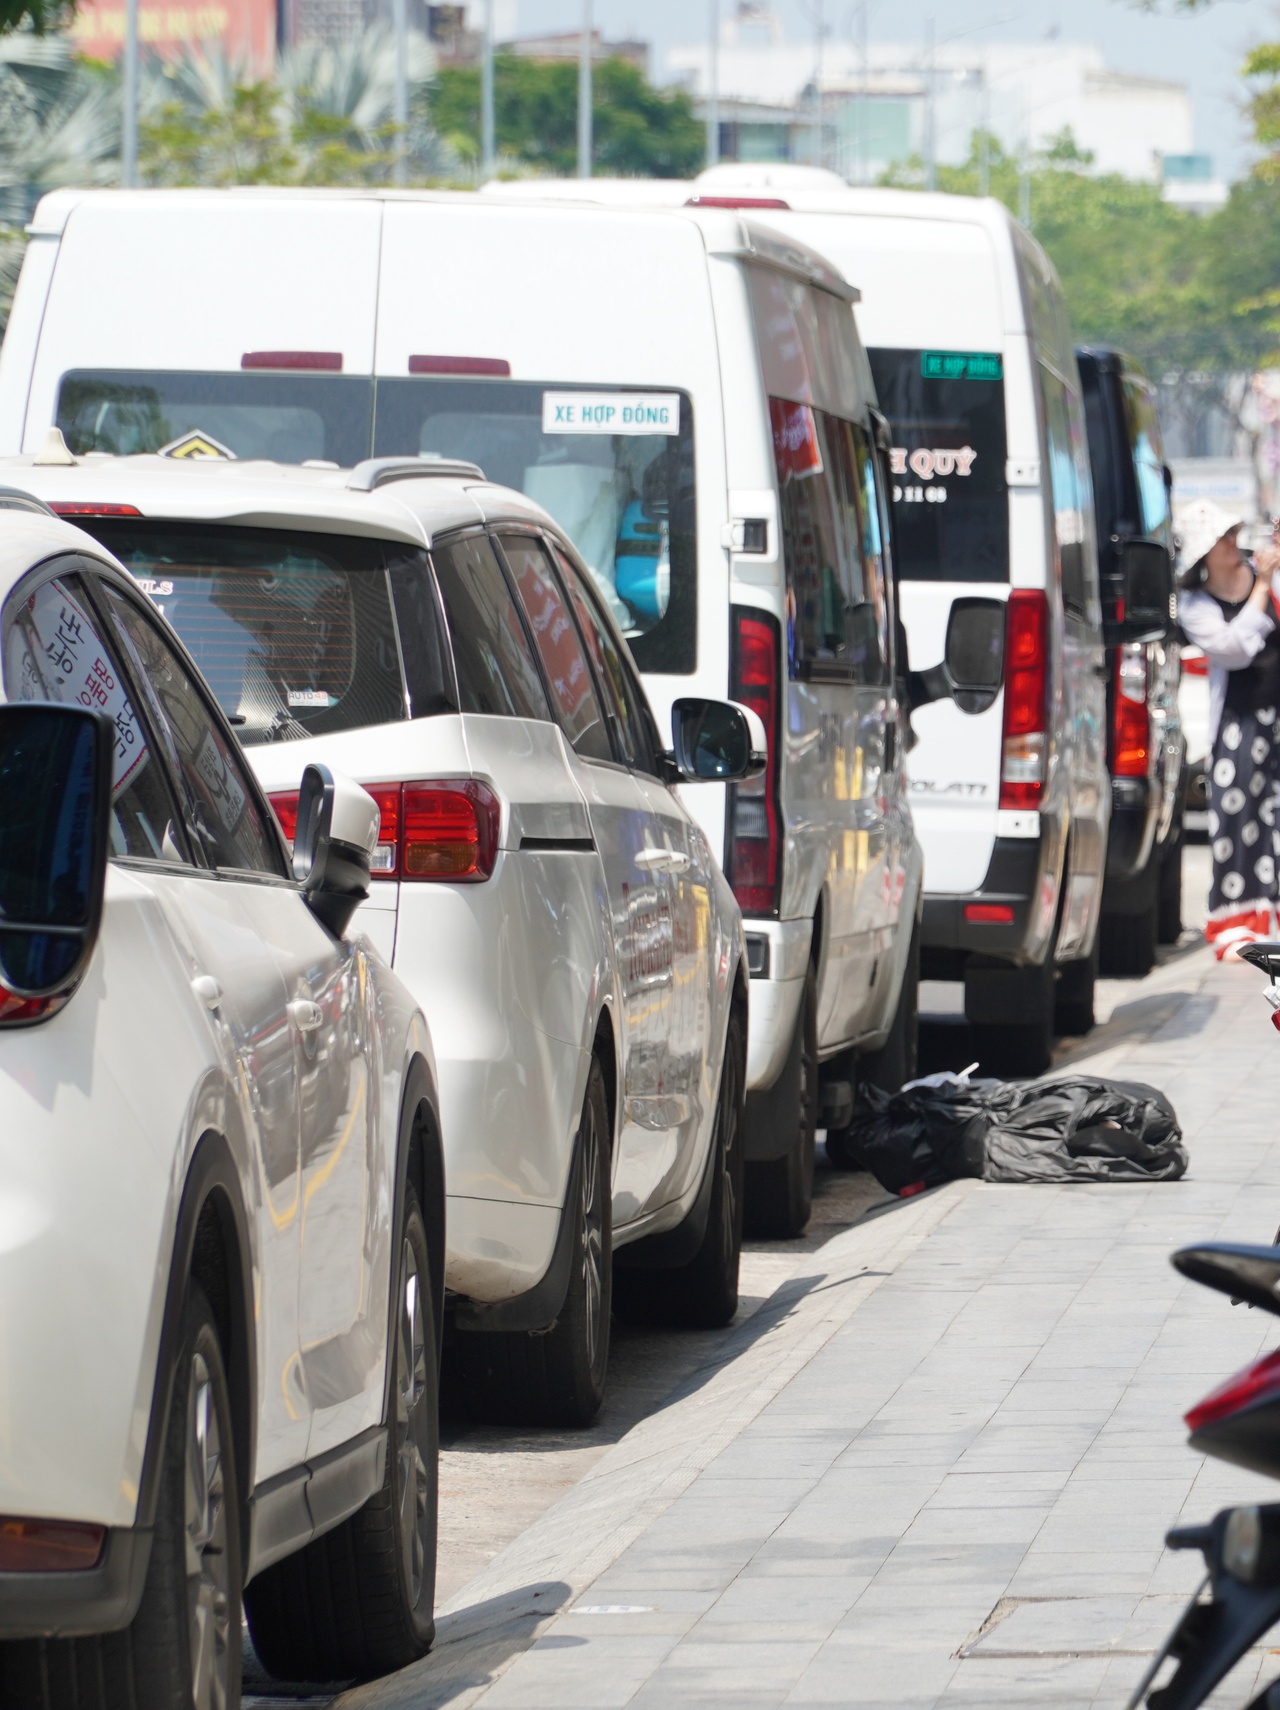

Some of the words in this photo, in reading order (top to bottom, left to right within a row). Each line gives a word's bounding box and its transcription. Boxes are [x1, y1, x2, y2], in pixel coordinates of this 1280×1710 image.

[555, 405, 575, 423] XE
[581, 405, 616, 428] HỢP
[622, 400, 670, 425] ĐỒNG
[909, 445, 977, 481] QUÝ
